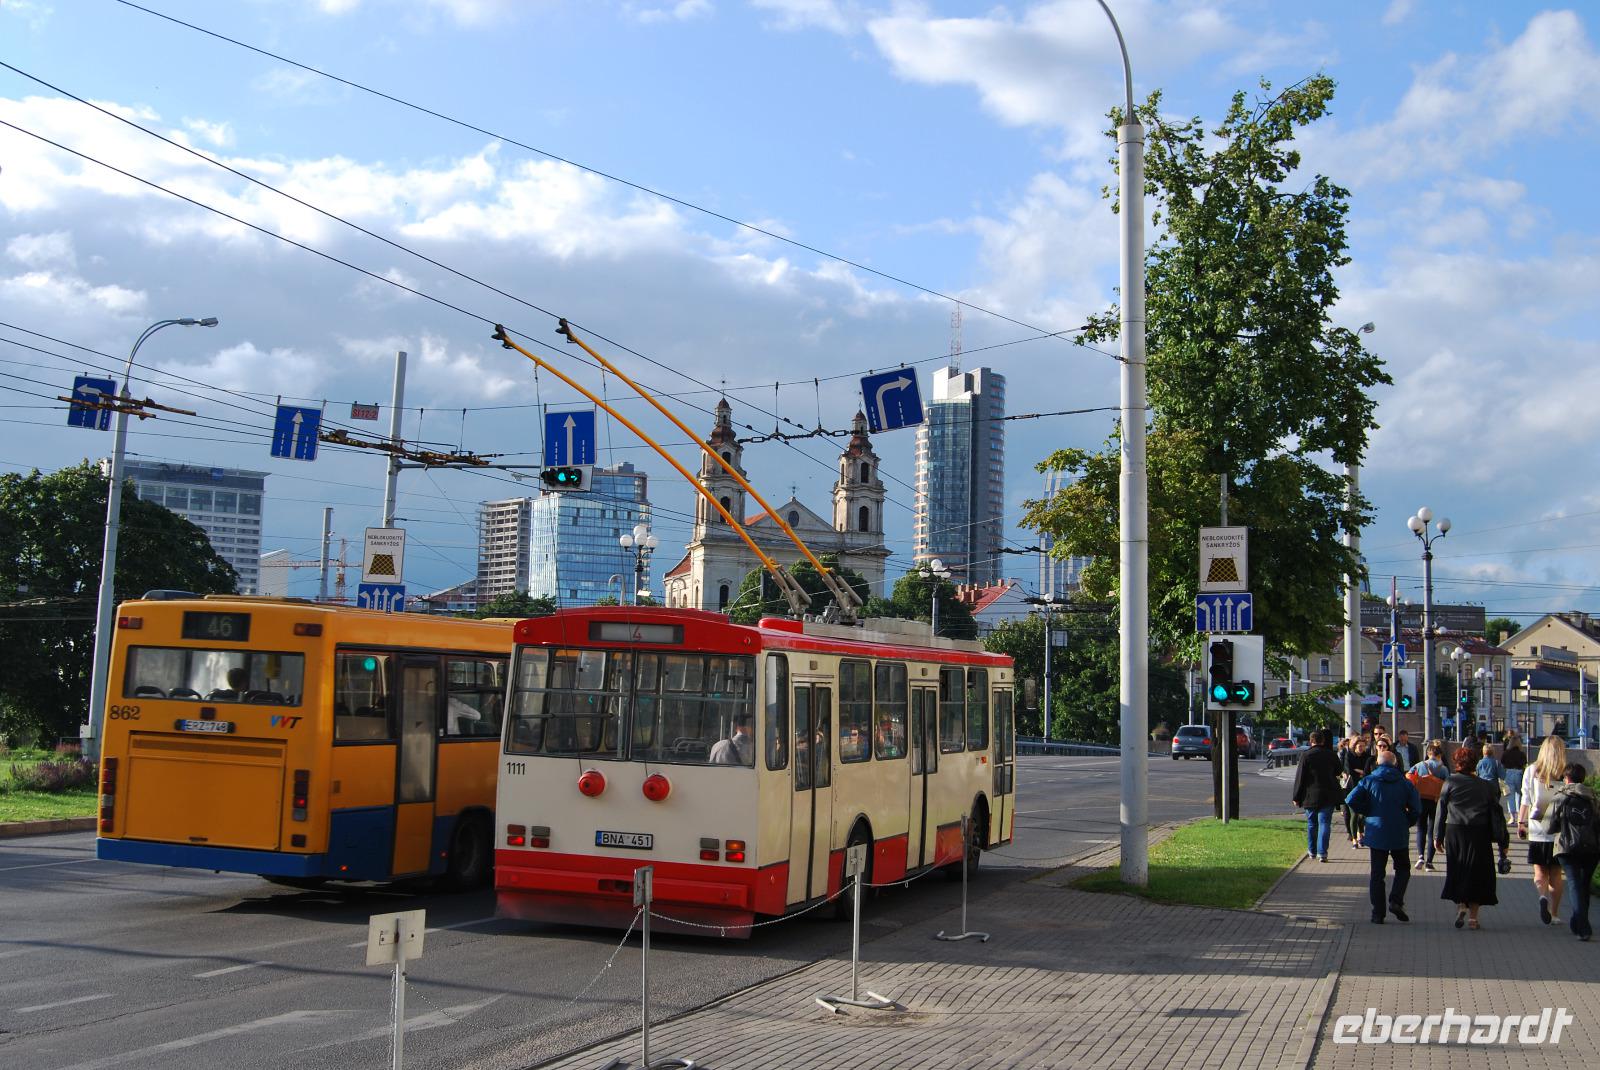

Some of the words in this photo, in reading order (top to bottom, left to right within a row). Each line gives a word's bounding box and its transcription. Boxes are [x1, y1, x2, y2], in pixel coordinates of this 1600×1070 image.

[208, 614, 233, 638] 46
[632, 624, 643, 641] 4
[110, 705, 141, 720] 862
[270, 714, 303, 729] VVT
[506, 761, 526, 776] 1111
[602, 833, 624, 845] BNA
[631, 835, 651, 847] 451
